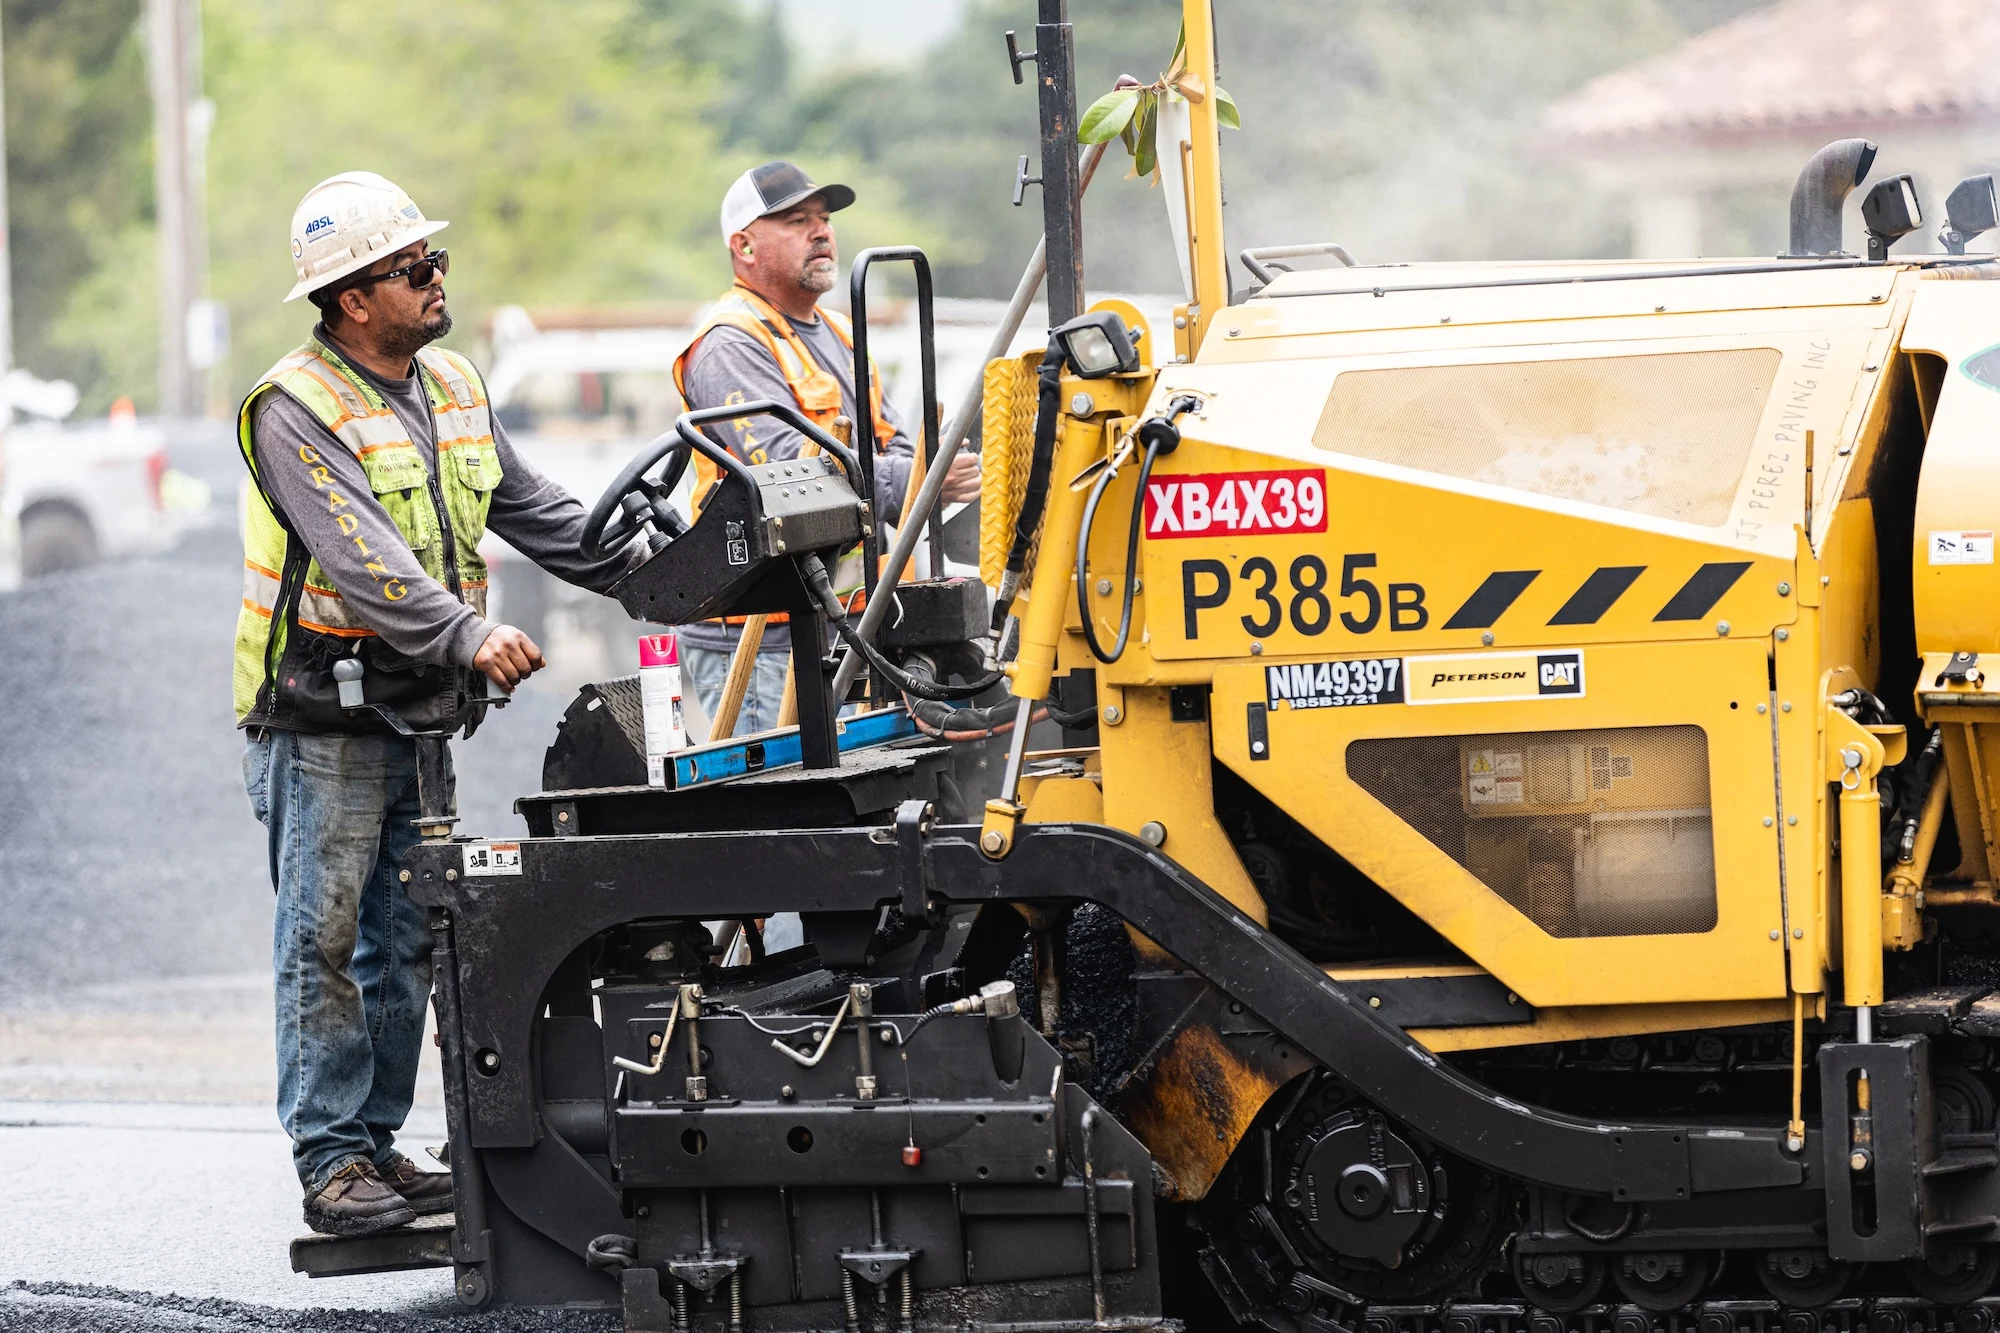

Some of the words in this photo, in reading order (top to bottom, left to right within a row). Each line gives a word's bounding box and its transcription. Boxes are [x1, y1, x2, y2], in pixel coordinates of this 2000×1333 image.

[305, 216, 334, 235] ABSL
[1775, 379, 1817, 443] PAVING
[1149, 476, 1325, 533] XB4X39
[1748, 453, 1790, 511] PEREZ
[299, 444, 408, 601] GRADING
[1735, 518, 1762, 541] JJ
[1181, 552, 1430, 640] P385B
[1267, 658, 1401, 699] NM49397
[1431, 671, 1527, 687] PETERSON
[1540, 662, 1578, 687] CAT
